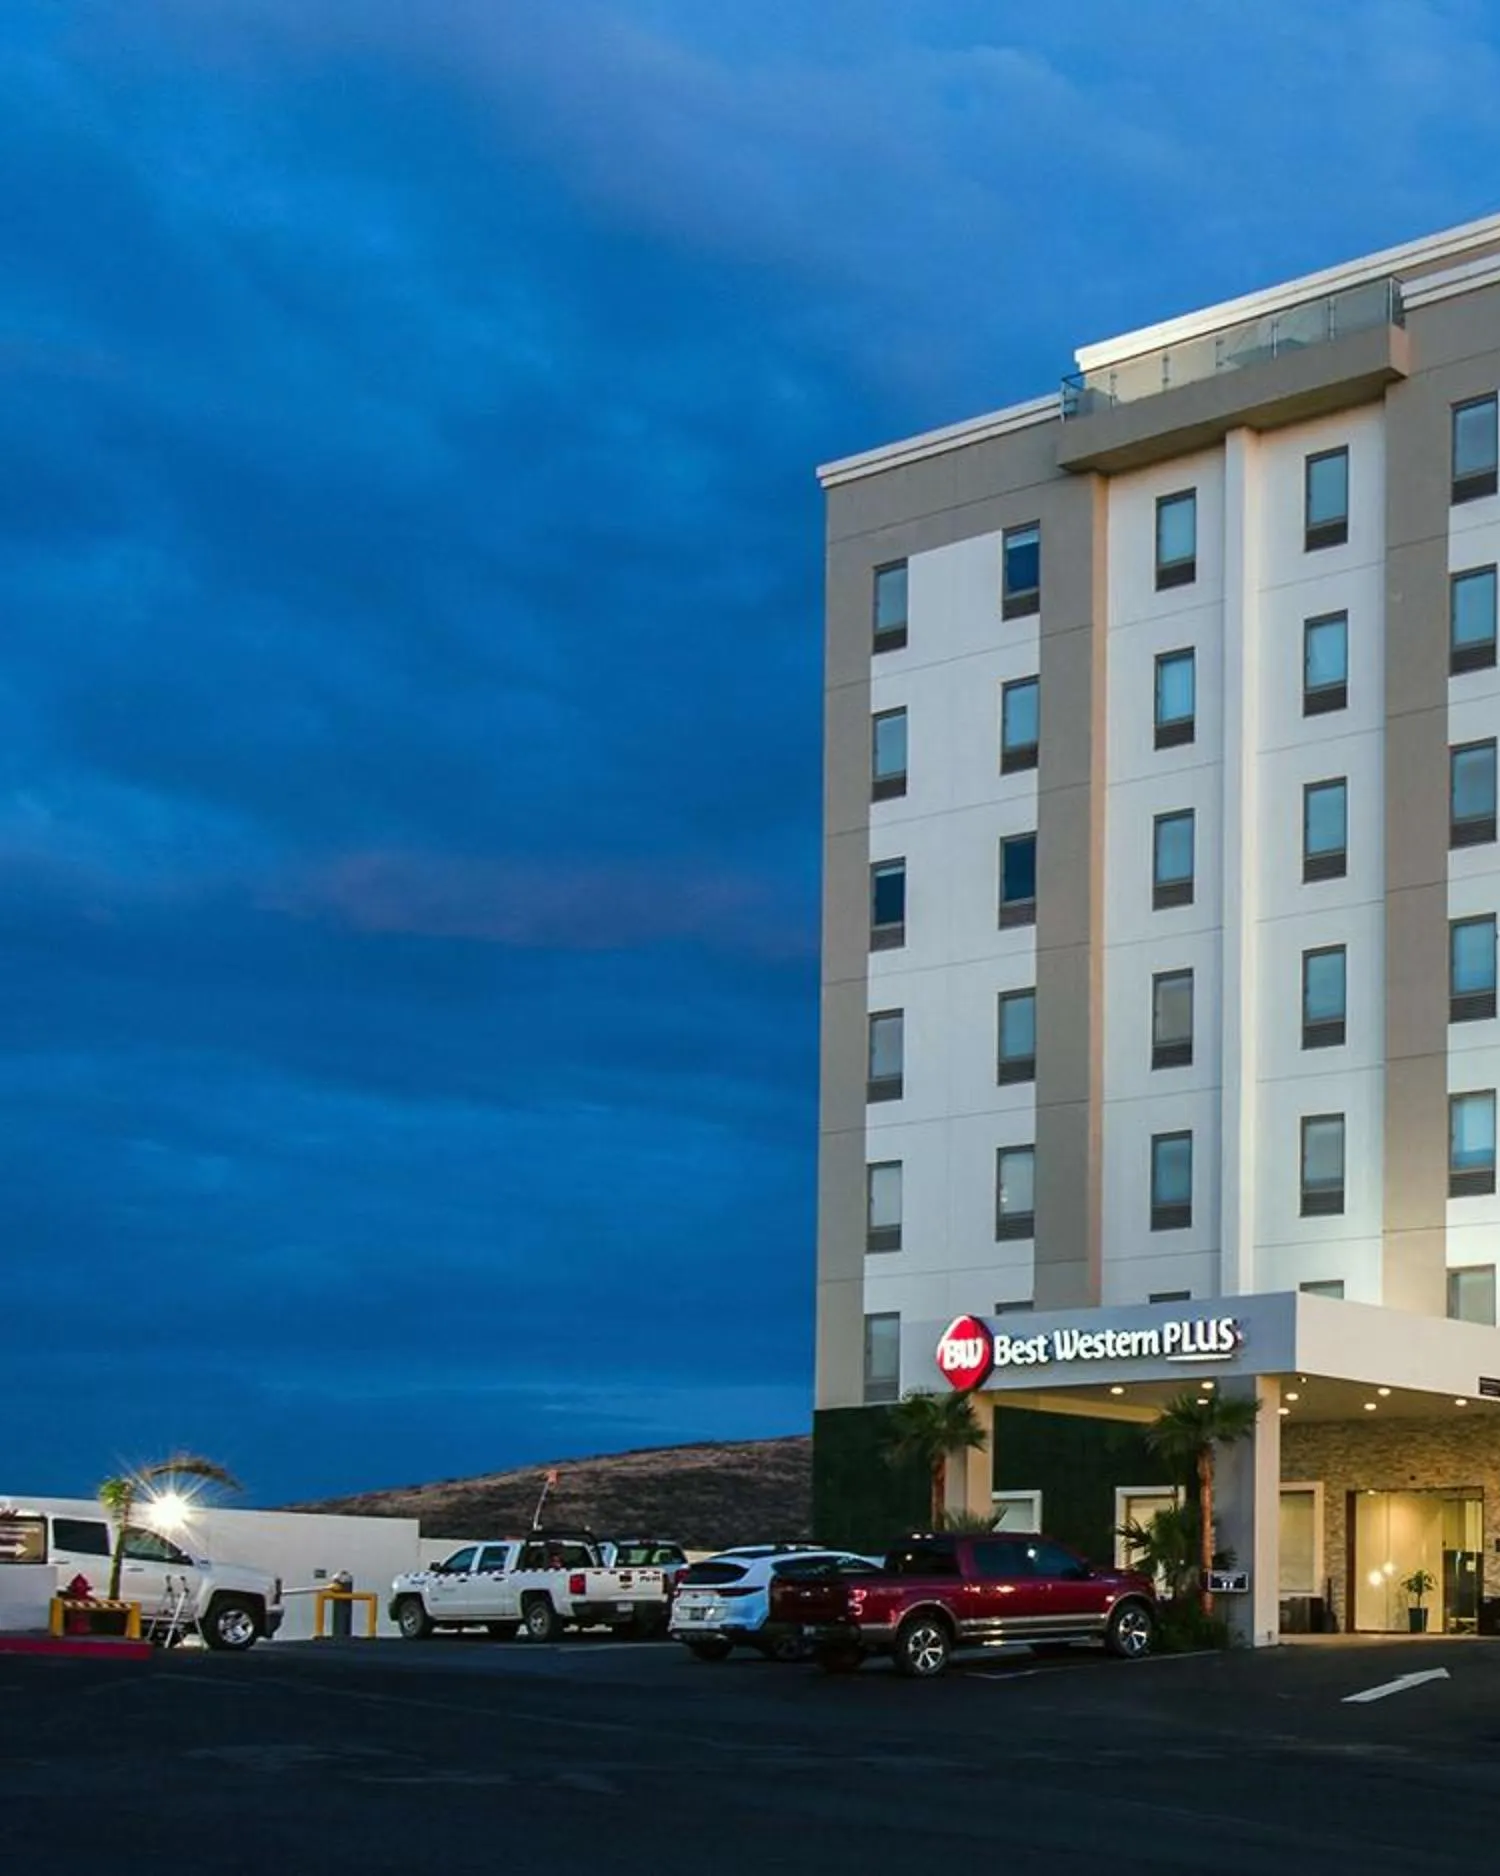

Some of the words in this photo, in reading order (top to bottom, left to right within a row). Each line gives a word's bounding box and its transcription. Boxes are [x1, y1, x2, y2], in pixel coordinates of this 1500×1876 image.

[940, 1337, 983, 1371] BW
[993, 1334, 1049, 1366] Best
[1052, 1327, 1161, 1361] Western
[1164, 1317, 1236, 1354] PLUS
